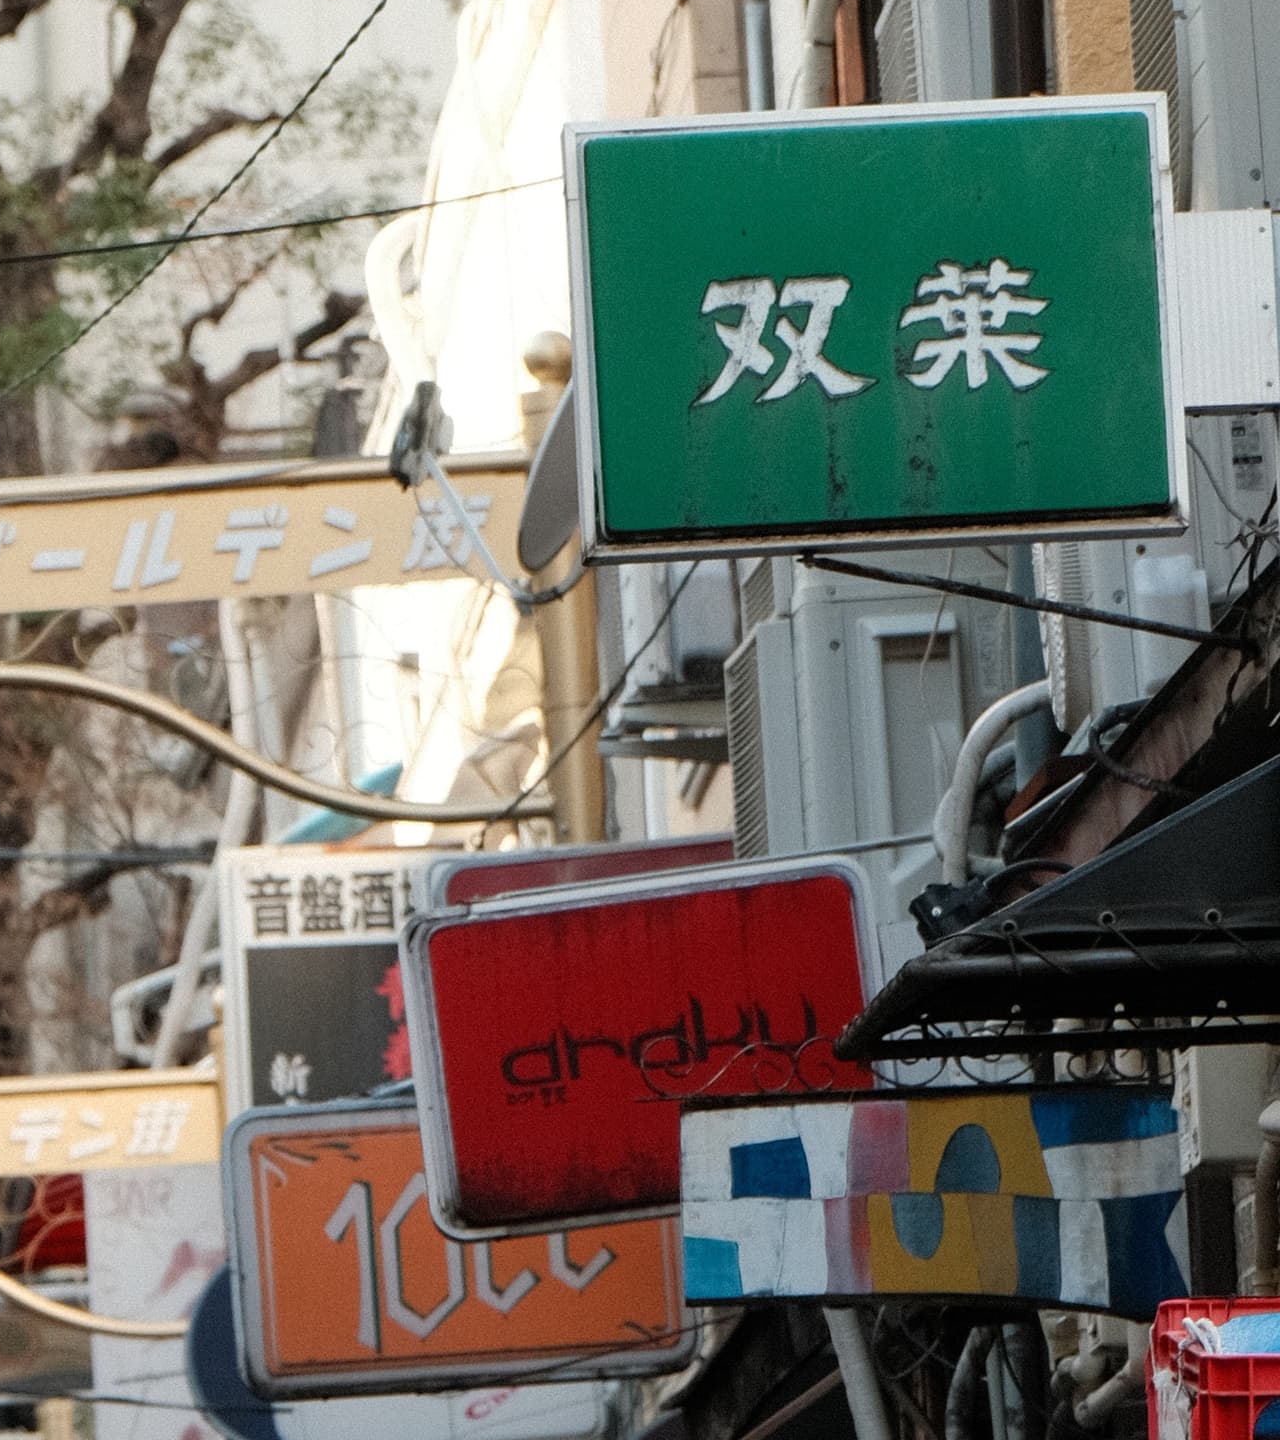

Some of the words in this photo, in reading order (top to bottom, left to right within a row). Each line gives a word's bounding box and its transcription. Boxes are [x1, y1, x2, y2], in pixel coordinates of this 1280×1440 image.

[690, 255, 1056, 410] 双葉
[246, 872, 416, 936] 音盤酒
